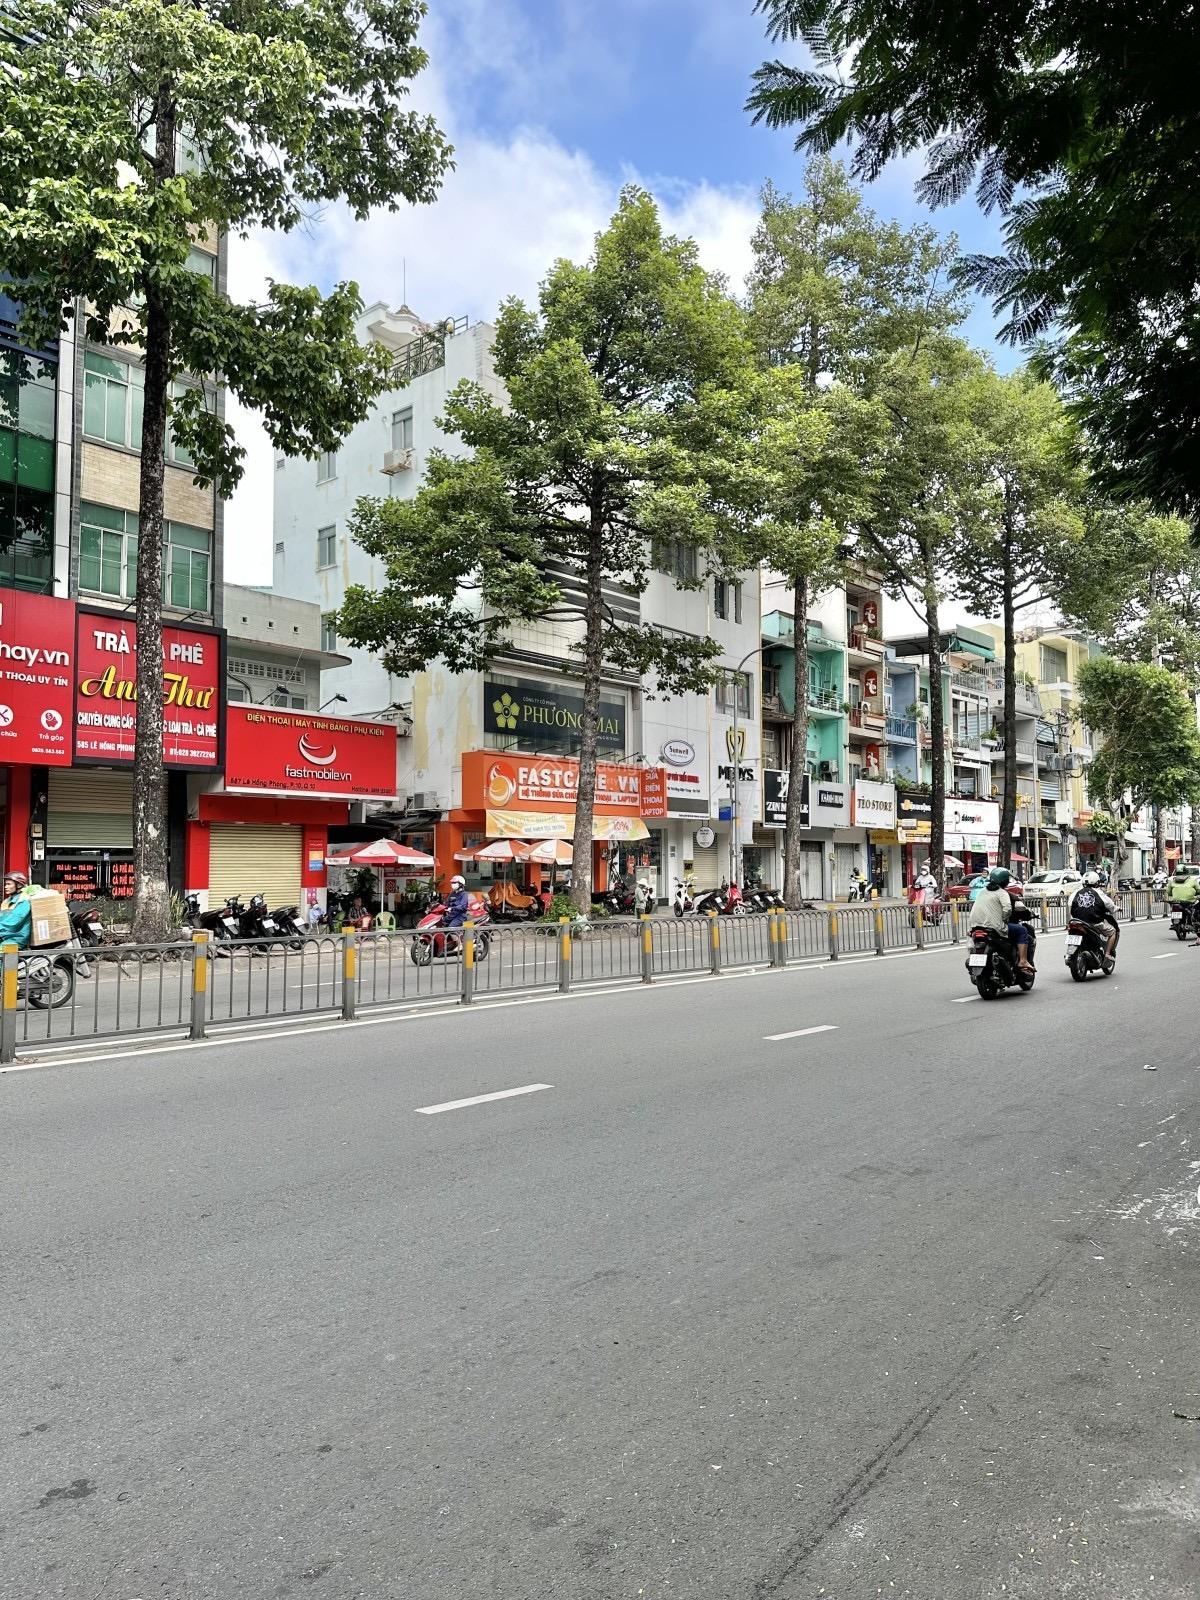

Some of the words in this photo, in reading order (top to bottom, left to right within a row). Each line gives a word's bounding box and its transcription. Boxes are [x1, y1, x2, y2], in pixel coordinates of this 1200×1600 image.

[93, 629, 130, 654] TRÀ
[170, 642, 204, 665] PHÊ
[6, 671, 36, 684] THOẠI
[38, 675, 51, 685] UY
[53, 675, 69, 686] TÍN
[78, 711, 102, 727] CHUYÊN
[104, 714, 121, 728] CUNG
[122, 713, 134, 729] CẤP
[182, 720, 193, 735] TRÀ
[197, 721, 206, 736] CÀ
[206, 723, 217, 738] PHÊ
[247, 713, 266, 723] ĐIỆN
[267, 715, 291, 726] THOẠI
[313, 720, 329, 730] TÍNH
[285, 764, 352, 782] fastmobile.vn
[518, 767, 607, 796] FASTCE
[641, 807, 664, 816] LAPTOP
[872, 800, 893, 811] STORE
